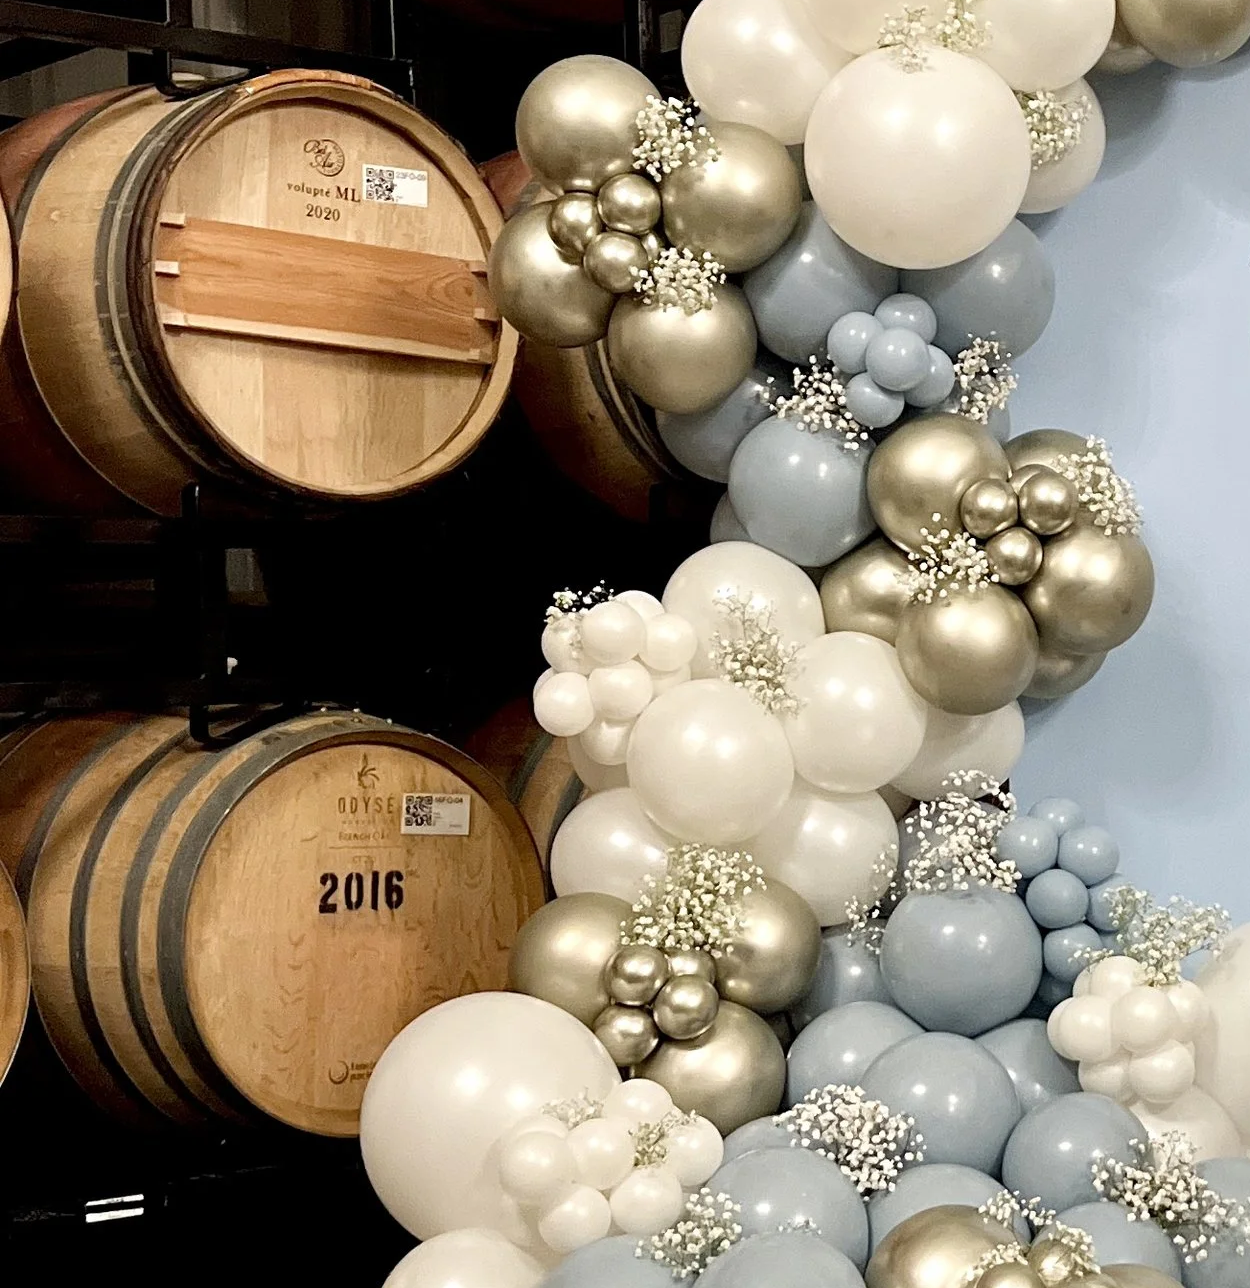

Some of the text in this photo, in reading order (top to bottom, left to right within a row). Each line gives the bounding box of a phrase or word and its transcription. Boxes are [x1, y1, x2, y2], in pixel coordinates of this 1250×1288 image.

[336, 185, 361, 203] ML
[305, 203, 341, 222] 2020
[318, 870, 405, 914] 2016
